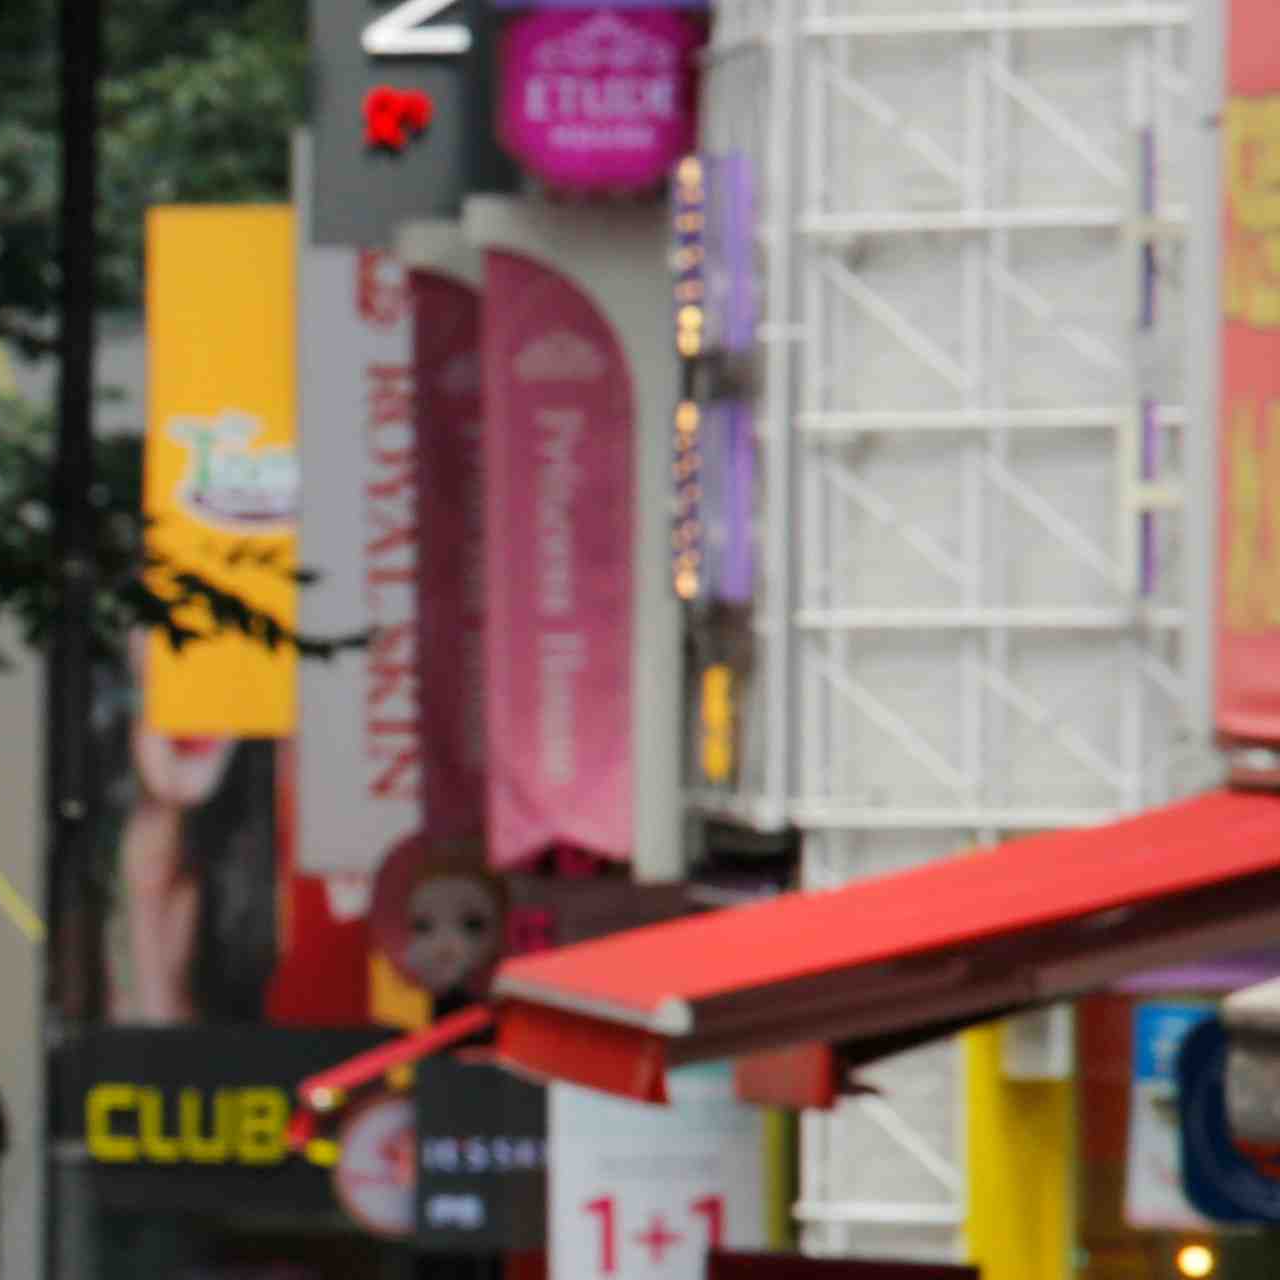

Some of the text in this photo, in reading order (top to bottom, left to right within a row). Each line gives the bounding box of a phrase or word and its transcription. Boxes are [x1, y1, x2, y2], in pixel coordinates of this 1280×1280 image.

[367, 363, 420, 802] ROYAL SKIN
[86, 1083, 290, 1163] CLUB
[577, 1194, 728, 1268] 1+1
